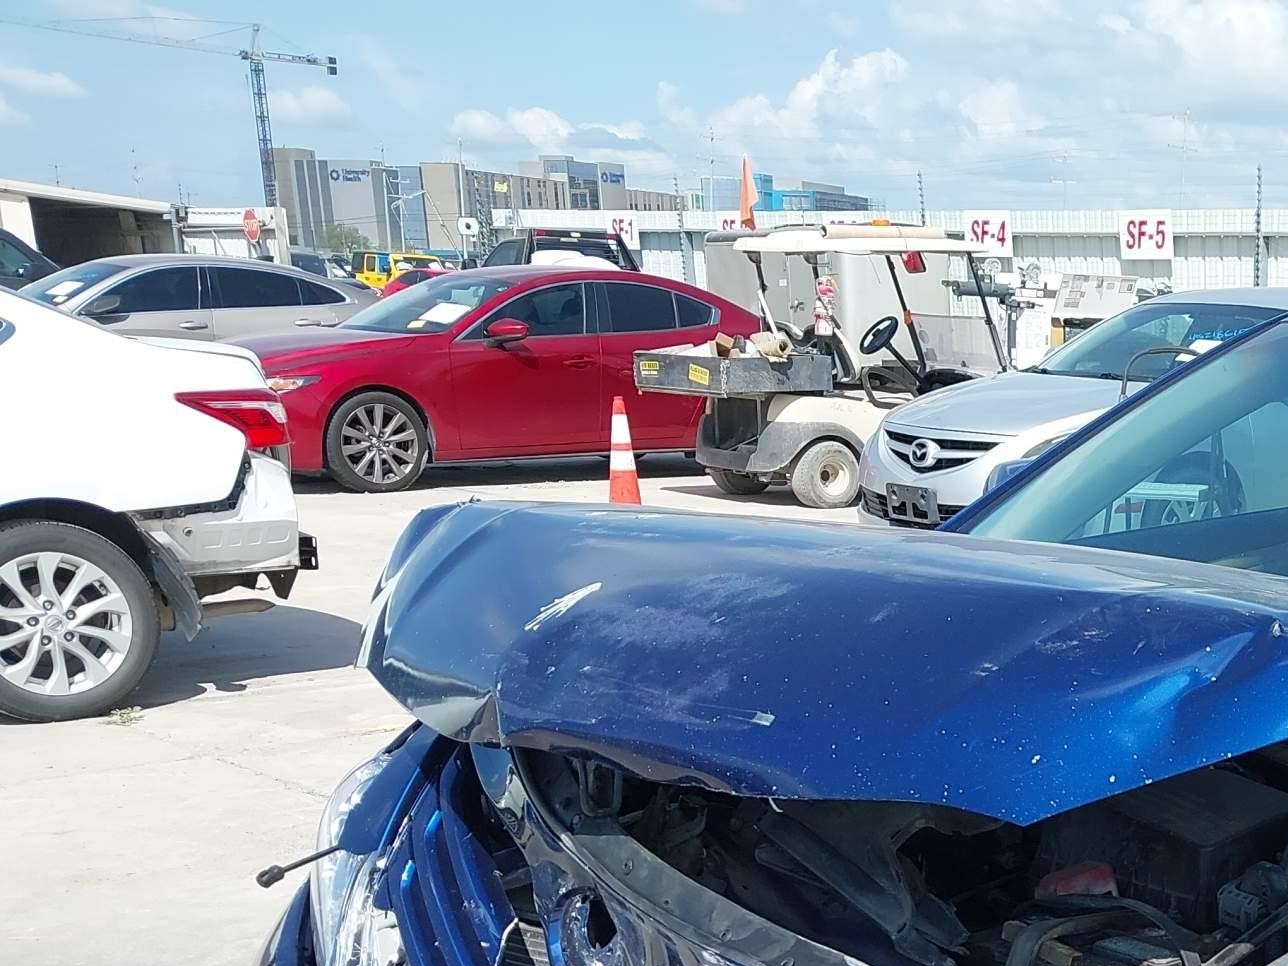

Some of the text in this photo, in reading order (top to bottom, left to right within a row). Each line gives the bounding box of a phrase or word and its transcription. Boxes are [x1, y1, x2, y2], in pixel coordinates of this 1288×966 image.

[612, 218, 633, 242] SF-1
[971, 219, 1006, 247] SF-4
[1126, 220, 1166, 250] SF-5
